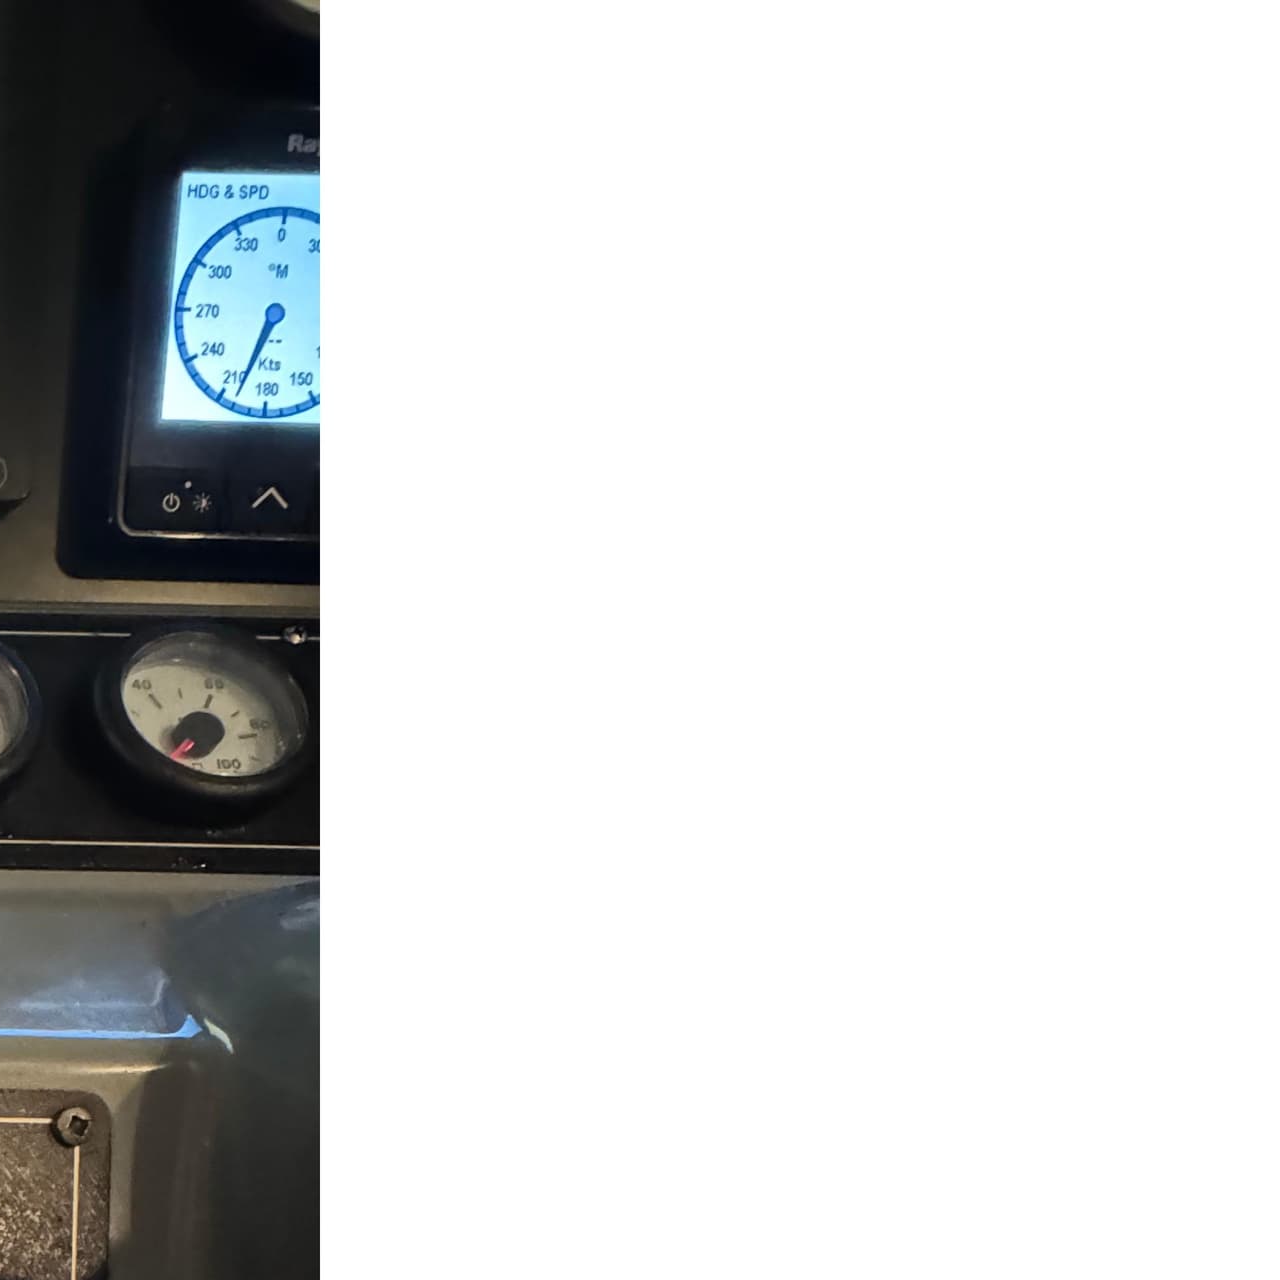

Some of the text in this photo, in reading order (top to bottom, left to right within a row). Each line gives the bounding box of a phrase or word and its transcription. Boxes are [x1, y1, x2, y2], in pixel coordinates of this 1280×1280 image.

[187, 184, 270, 200] HDG & SPD
[278, 227, 286, 242] 0
[234, 237, 259, 252] 330
[208, 264, 233, 280] 300
[195, 303, 220, 319] 270
[200, 342, 225, 357] 240
[258, 357, 281, 371] Kts
[289, 371, 314, 387] 150
[255, 382, 279, 397] 180
[131, 679, 152, 690] 40
[216, 758, 242, 770] 100
